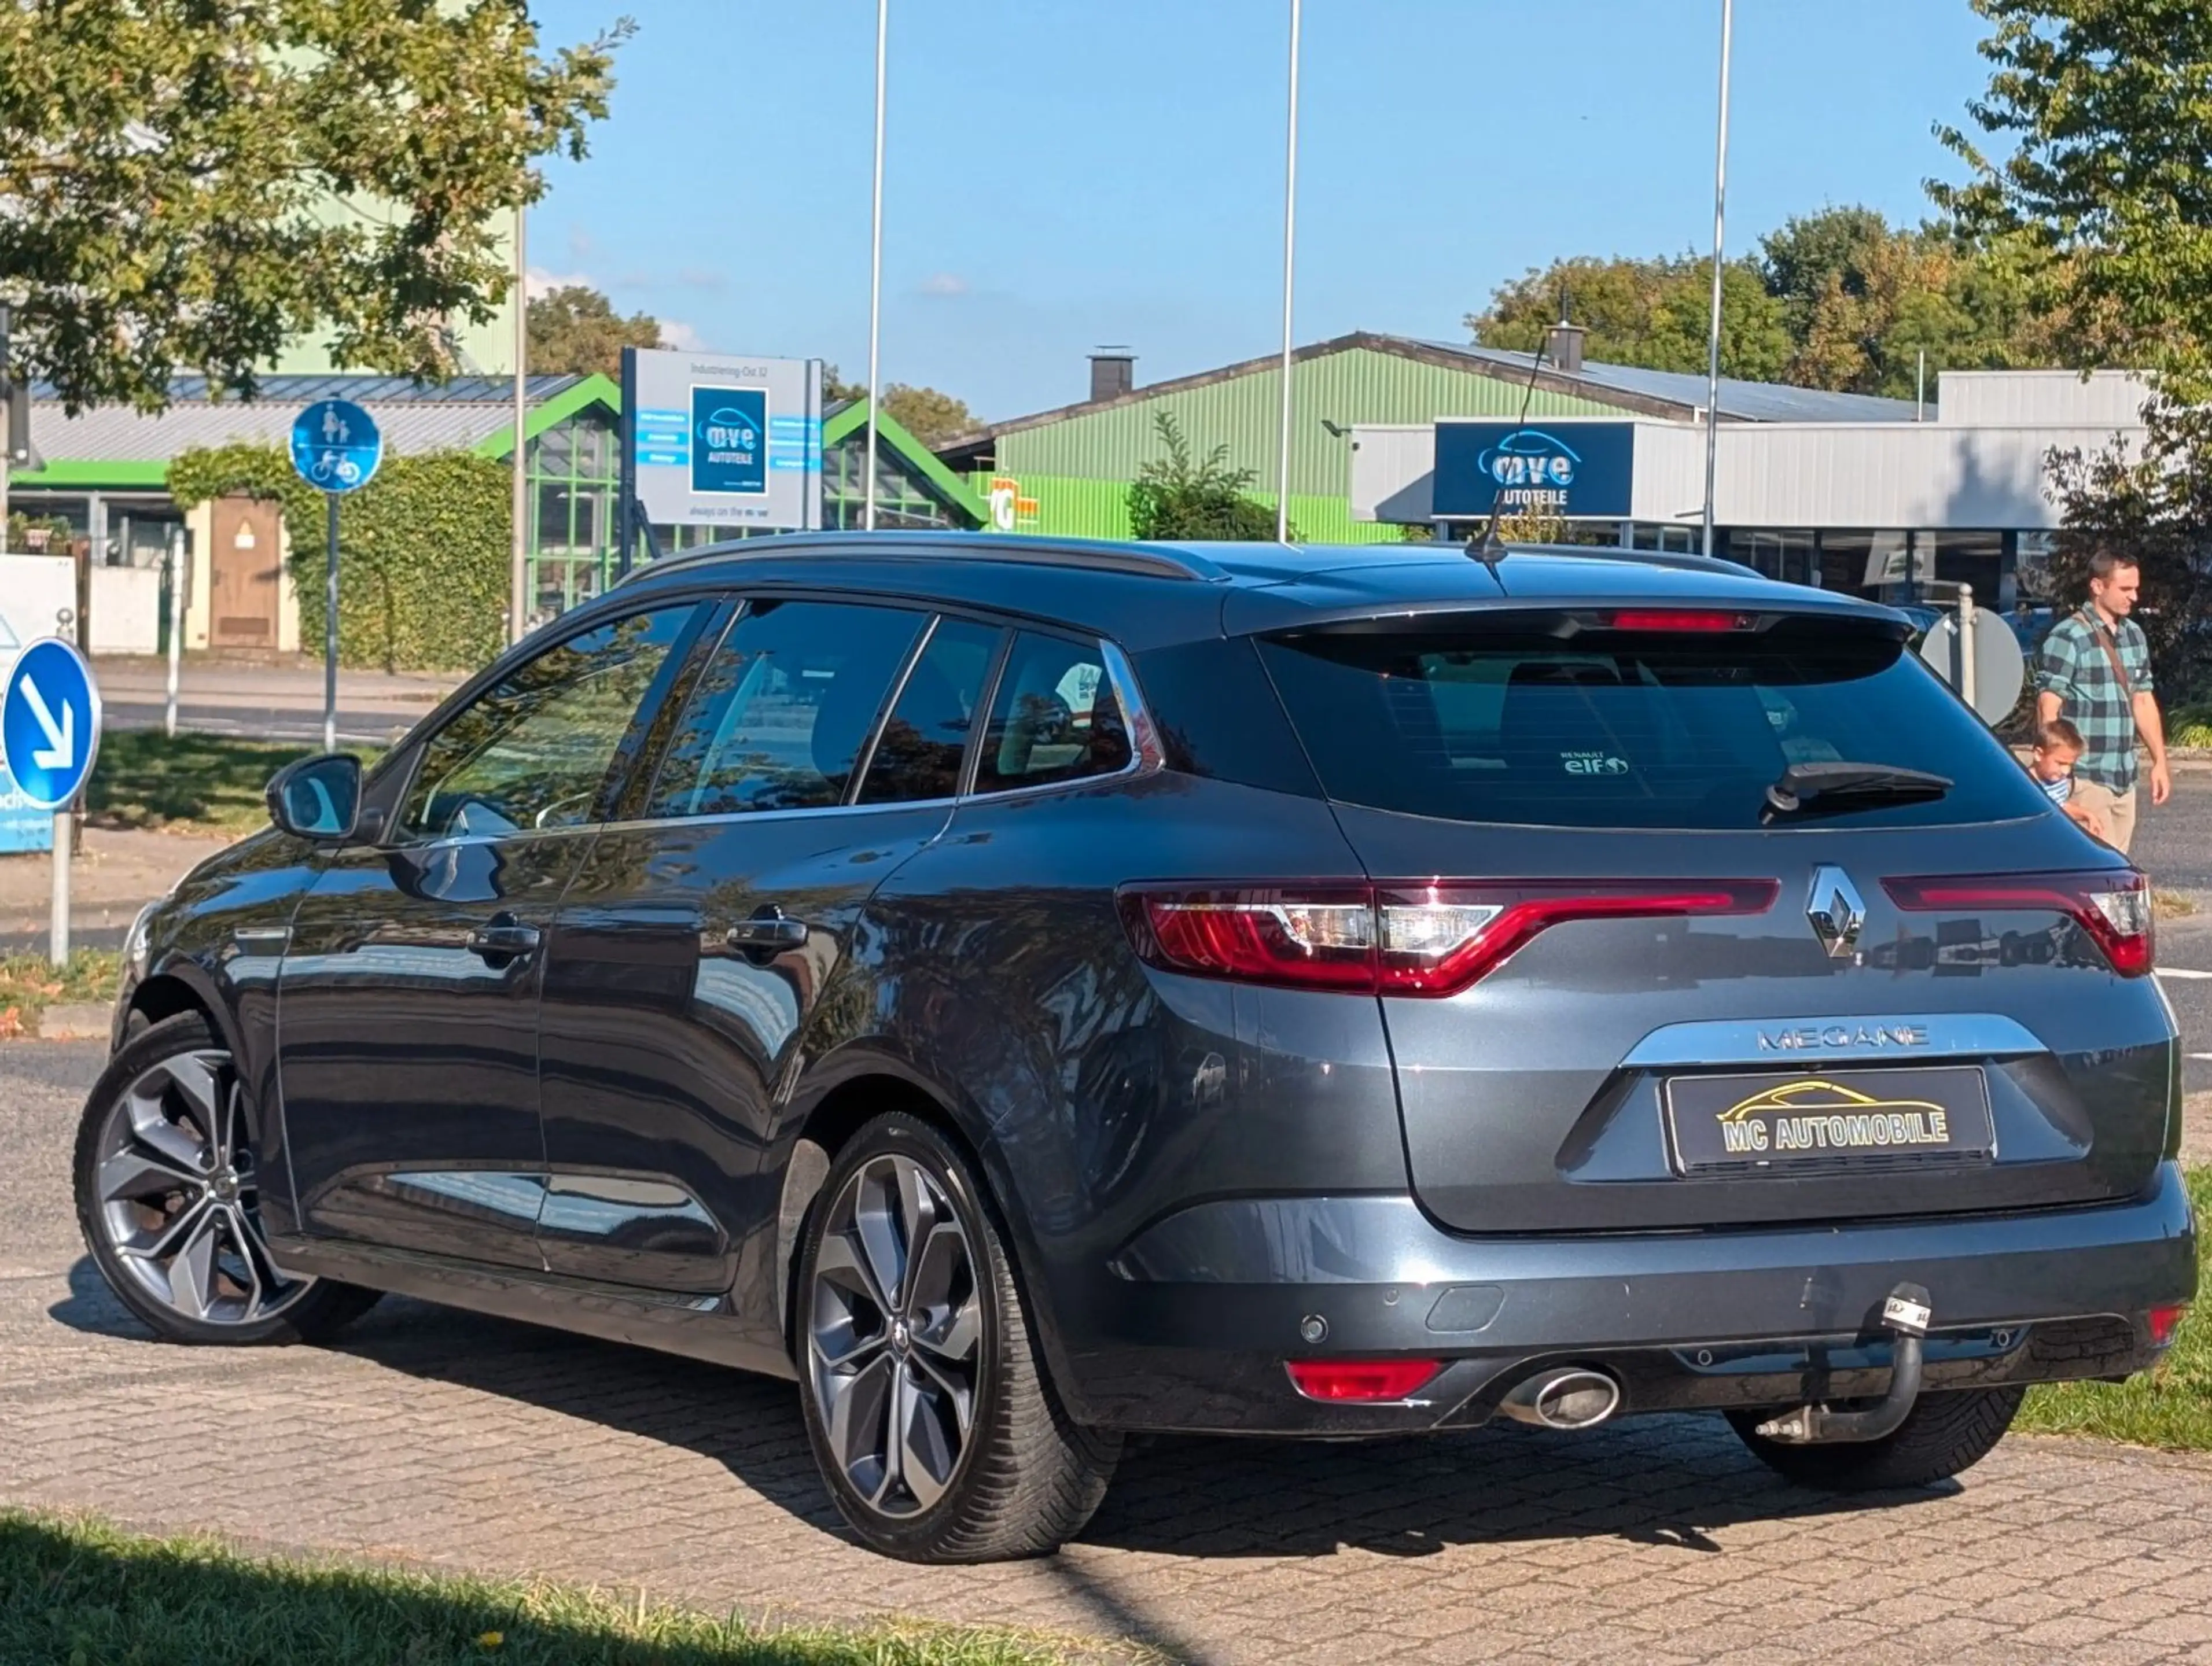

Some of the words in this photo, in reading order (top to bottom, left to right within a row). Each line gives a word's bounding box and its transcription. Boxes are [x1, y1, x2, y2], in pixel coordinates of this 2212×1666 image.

[706, 426, 756, 449] mve
[708, 452, 753, 465] AUTOTEILE
[1492, 456, 1574, 485] mve
[1565, 759, 1603, 773] elf
[1757, 1024, 1930, 1051] MEGANE
[1722, 1119, 1768, 1152] MC
[1776, 1112, 1949, 1150] AUTOMOBILE
